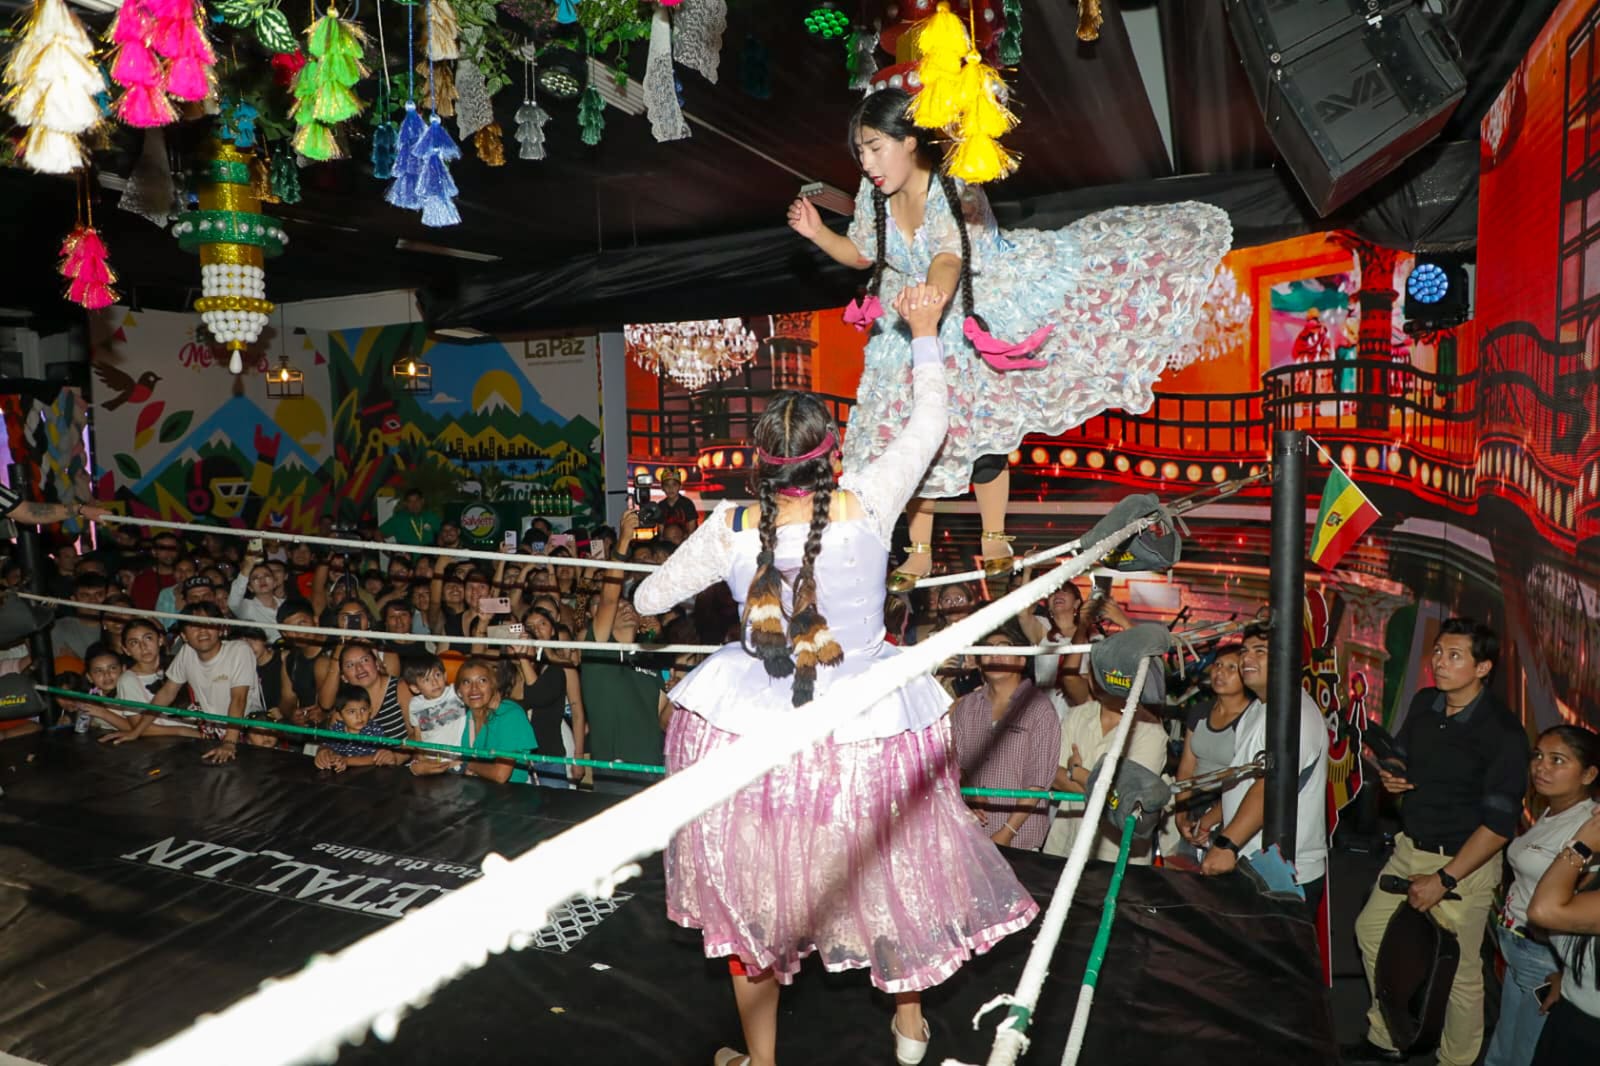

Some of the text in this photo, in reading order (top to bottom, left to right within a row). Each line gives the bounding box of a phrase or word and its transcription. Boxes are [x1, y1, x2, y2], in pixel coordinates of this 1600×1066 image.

[312, 842, 485, 878] rica de Mallas
